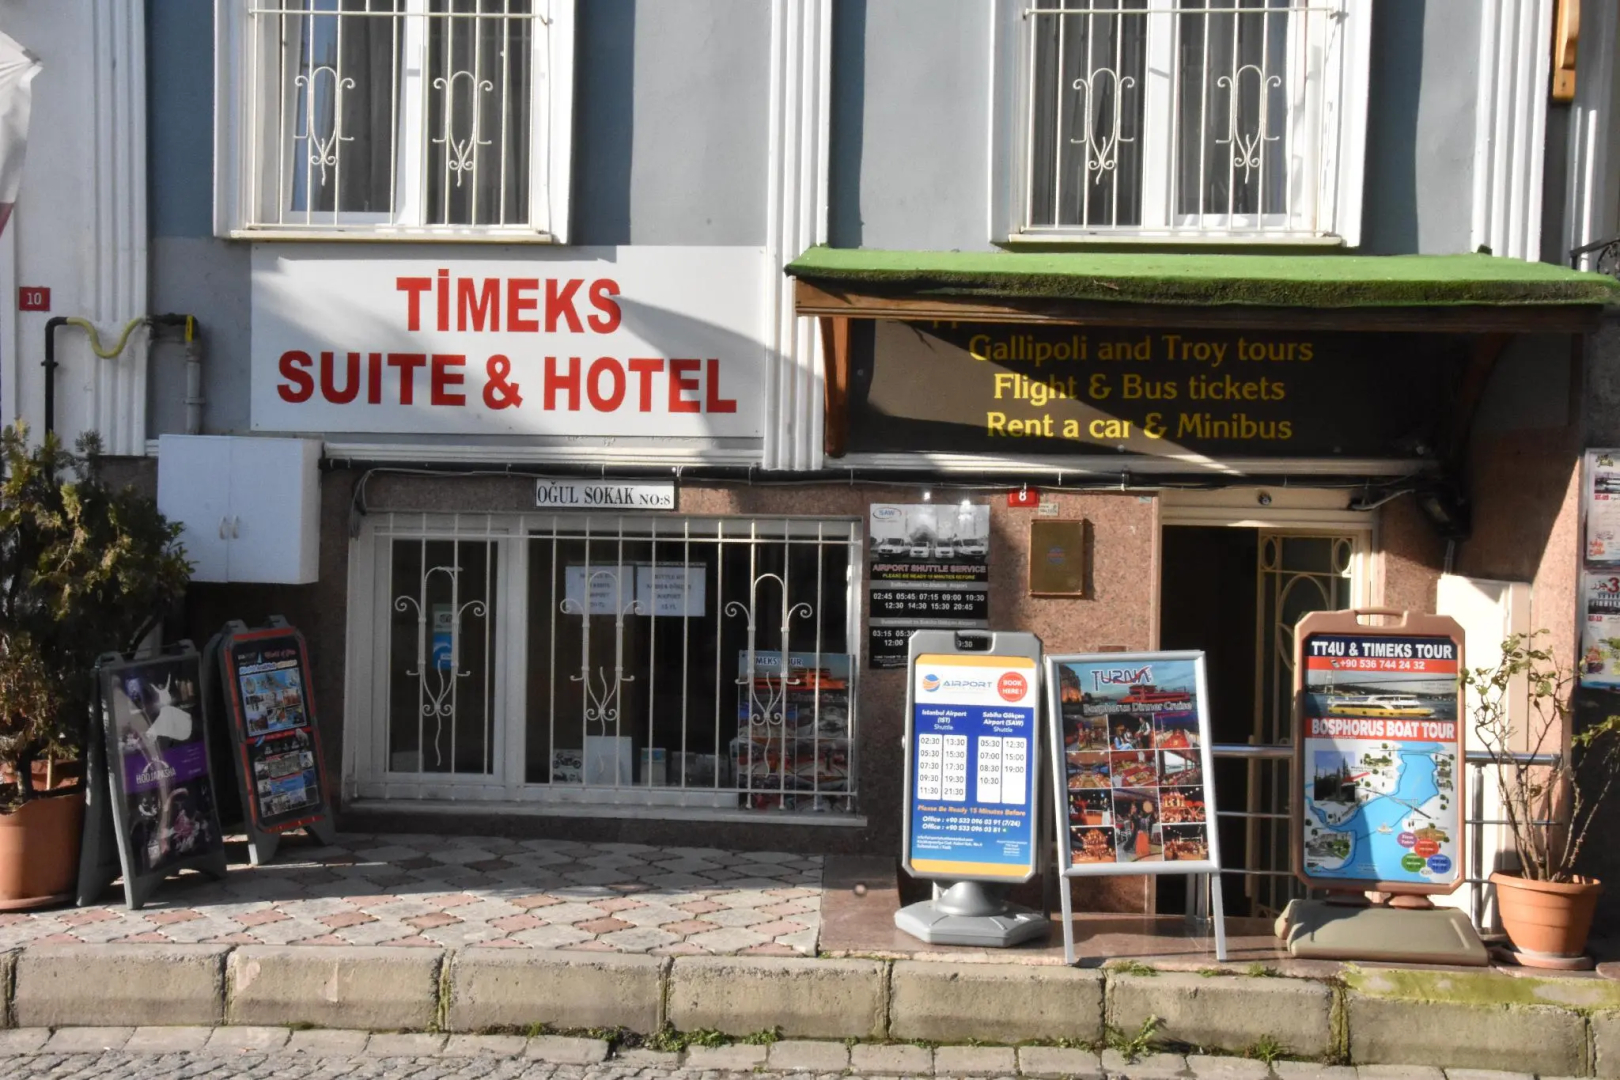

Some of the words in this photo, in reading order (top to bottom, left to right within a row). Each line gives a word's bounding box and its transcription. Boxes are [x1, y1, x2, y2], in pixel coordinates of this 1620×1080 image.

[27, 292, 42, 305] 10
[396, 268, 622, 335] TİMEKS
[969, 335, 1087, 367] Gallipoli
[1097, 335, 1151, 361] and
[1162, 335, 1227, 367] Troy
[1237, 338, 1314, 361] tours
[277, 350, 467, 406] SUITE
[482, 354, 523, 411] &
[543, 356, 737, 414] HOTEL
[994, 373, 1077, 406] Flight
[1089, 374, 1112, 399] &
[1122, 374, 1178, 400] Bus
[1188, 373, 1286, 400] tickets
[987, 412, 1054, 438] Rent
[1062, 420, 1079, 438] a
[1089, 420, 1132, 439] car
[1143, 413, 1166, 439] &
[1177, 413, 1293, 440] Minibus
[537, 481, 579, 504] OĞUL
[584, 487, 634, 505] SOKAK
[639, 494, 671, 506] NO:8
[1018, 489, 1027, 502] 8
[872, 563, 909, 572] AIRPORT
[911, 564, 949, 573] SHUTTLE
[950, 565, 987, 574] SERVICE
[1607, 577, 1620, 594] 3
[873, 592, 893, 600] 02:45
[919, 593, 939, 601] 07:15
[942, 593, 962, 601] 09:00
[965, 594, 985, 602] 10:30
[908, 602, 927, 610] 14:30
[953, 603, 973, 611] 20:45
[884, 639, 904, 647] 12:00
[1311, 641, 1345, 656] TT4U
[1348, 643, 1359, 657] &
[1362, 643, 1412, 658] TIMEKS
[1415, 644, 1452, 659] TOUR
[1340, 660, 1357, 668] +90
[1359, 660, 1377, 668] 536
[1379, 661, 1396, 669] 744
[1399, 661, 1411, 669] 24
[1413, 661, 1425, 670] 32
[1092, 665, 1152, 691] TURNA
[1083, 703, 1131, 715] Bosphorus
[1131, 702, 1163, 712] Dinner
[1163, 701, 1192, 711] Cruise
[982, 711, 1002, 719] Sabiha
[933, 723, 954, 731] Shuttle
[983, 718, 1005, 727] Airport
[1312, 718, 1384, 737] BOSPHORUS
[1386, 720, 1419, 738] BOAT
[1422, 722, 1455, 739] TOUR
[920, 737, 940, 745] 02:30
[946, 738, 966, 746] 13:30
[980, 740, 1000, 748] 05:30
[1005, 741, 1025, 749] 12:30
[920, 750, 940, 758] 05:30
[945, 751, 965, 759] 15:30
[980, 752, 1000, 760] 07:00
[1005, 753, 1025, 761] 15:00
[919, 762, 939, 770] 07:30
[945, 763, 965, 771] 17:30
[979, 765, 1000, 773] 08:30
[1005, 765, 1025, 774] 19:00
[919, 774, 939, 782] 09:30
[945, 775, 965, 783] 19:30
[980, 777, 1000, 785] 10:30
[920, 786, 939, 795] 11:30
[944, 788, 964, 796] 21:30
[917, 804, 937, 812] Please
[948, 806, 967, 814] Ready
[979, 807, 1003, 815] Minutes
